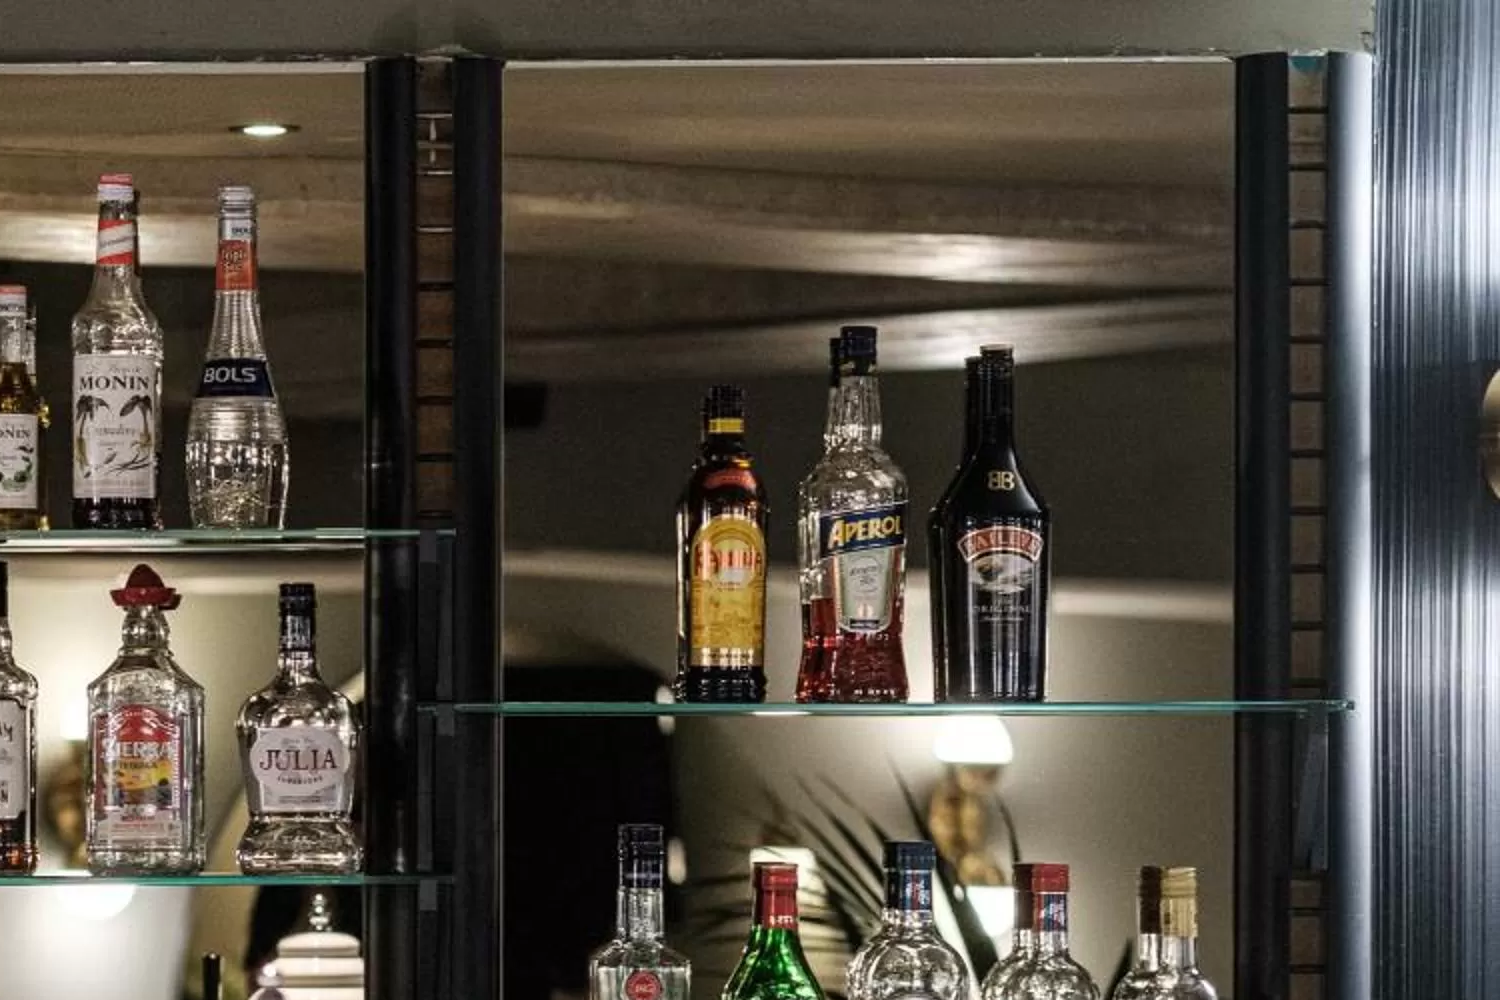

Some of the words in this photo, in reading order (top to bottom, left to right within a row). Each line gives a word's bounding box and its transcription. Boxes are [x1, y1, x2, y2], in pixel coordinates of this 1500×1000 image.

[79, 375, 150, 390] MONIN
[203, 366, 257, 384] BOLS
[827, 515, 903, 550] APEROL
[259, 748, 339, 771] JULIA
